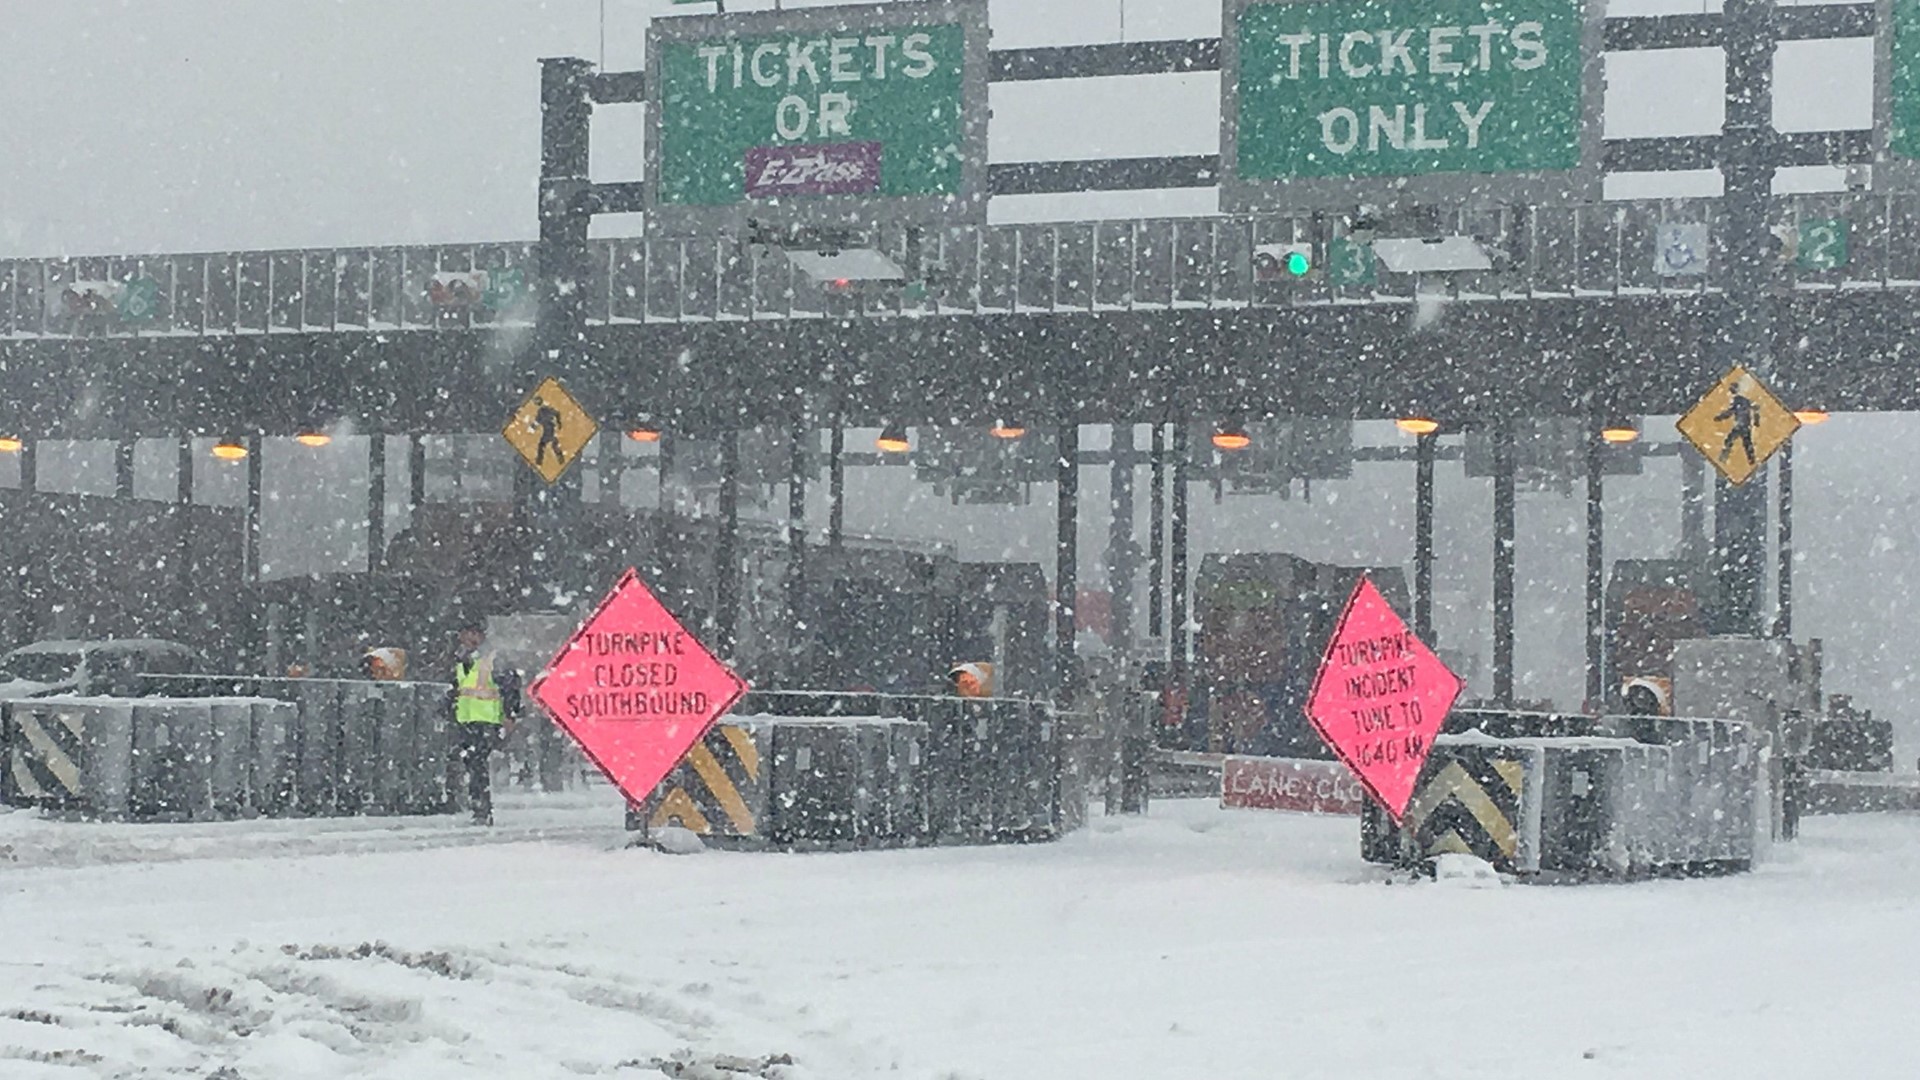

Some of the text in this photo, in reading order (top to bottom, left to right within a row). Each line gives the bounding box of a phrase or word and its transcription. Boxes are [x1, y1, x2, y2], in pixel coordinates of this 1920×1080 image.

[698, 33, 937, 93] TICKETS
[1278, 21, 1548, 79] TICKETS
[775, 91, 857, 140] OR
[1320, 101, 1495, 154] ONLY
[1341, 243, 1366, 283] 3
[1809, 226, 1836, 269] 2
[586, 631, 686, 656] TURNPIKE
[1337, 630, 1415, 667] TURNPIKE
[594, 662, 678, 688] CLOSED
[1344, 665, 1416, 699] INCIDENT
[566, 691, 707, 720] SOUTHBOUND
[1351, 700, 1423, 735] TUNE TO
[1355, 739, 1398, 768] 1640
[1231, 772, 1300, 797] LANE
